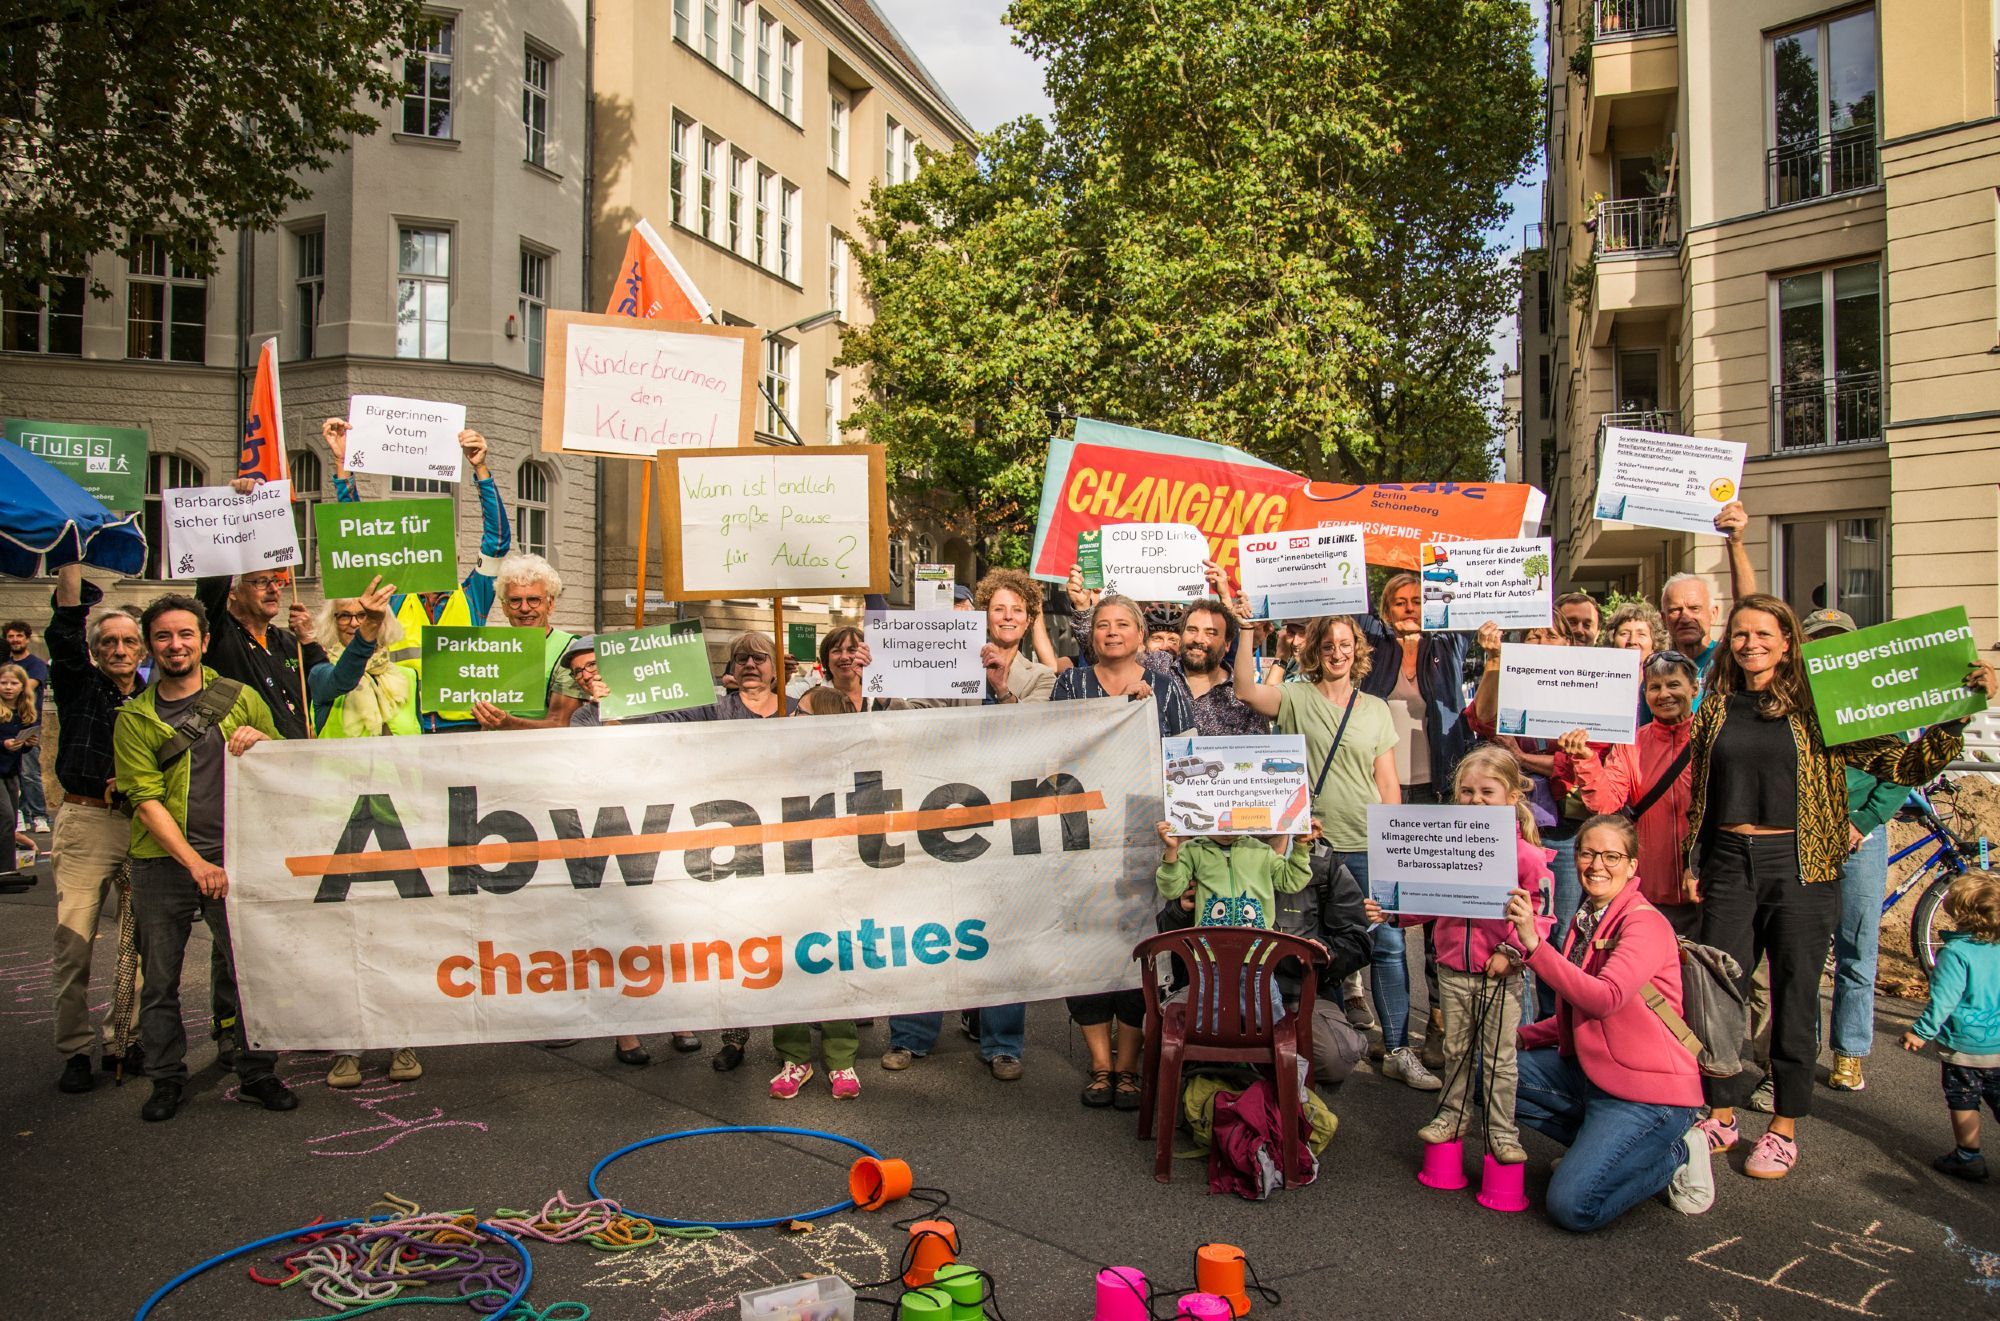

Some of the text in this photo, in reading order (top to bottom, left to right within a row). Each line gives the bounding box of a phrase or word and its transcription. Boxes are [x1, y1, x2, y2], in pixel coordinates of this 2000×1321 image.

[631, 386, 662, 406] den
[366, 405, 448, 423] Bürger:innen-
[386, 425, 427, 438] Votum
[596, 403, 718, 448] Kindern!
[29, 437, 104, 455] fuss
[382, 443, 428, 455] achten!
[1618, 443, 1646, 452] beteiligung
[1640, 438, 1666, 446] Menschen
[90, 462, 107, 470] e.V.
[744, 475, 767, 496] ist
[778, 474, 835, 494] endlich
[1645, 479, 1680, 488] Veranstaltung
[175, 489, 280, 508] Barbarossaplatz
[1373, 491, 1407, 501] Berlin
[1370, 500, 1440, 517] Schöneberg
[174, 508, 285, 528] sicher für unsere
[720, 505, 831, 536] große Pause
[340, 516, 430, 537] Platz für
[1317, 520, 1422, 539] VERSWENDE
[213, 529, 256, 544] Kinder!
[1112, 531, 1137, 541] CDU
[1141, 531, 1164, 540] SPD
[1246, 541, 1277, 552] CDU
[1290, 537, 1309, 549] SPD
[1318, 537, 1331, 545] DIE
[1450, 548, 1481, 557] Planung
[1483, 547, 1494, 555] für
[1511, 544, 1541, 553] Zukunft
[332, 547, 442, 569] Menschen
[1142, 547, 1167, 557] FDP:
[723, 548, 748, 573] für
[1277, 562, 1327, 573] unerwünscht
[1498, 557, 1524, 565] Kinder
[1105, 564, 1204, 574] Vertrauensbruch
[1502, 578, 1532, 587] Asphalt
[1457, 591, 1471, 599] und
[1494, 590, 1506, 598] für
[1508, 589, 1536, 597] Autos?
[873, 618, 977, 632] Barbarossaplatz
[437, 637, 522, 652] Parkbank
[600, 628, 696, 656] Die Zukunft
[883, 638, 967, 652] klimagerecht
[1807, 625, 1973, 675] Bürgerstimmen
[634, 659, 671, 681] geht
[893, 658, 957, 669] umbauen!
[459, 664, 499, 678] statt
[1506, 665, 1557, 675] Engagement
[1577, 669, 1632, 679] Bürger:innen
[1871, 665, 1919, 689] oder
[1537, 679, 1598, 689] ernst nehmen!
[440, 688, 524, 703] Parkplatz
[626, 683, 688, 705] zu Fuß.
[1187, 778, 1209, 786] Mehr
[1233, 777, 1248, 785] und
[1250, 776, 1301, 785] Entsiegelung
[1196, 788, 1293, 797] statt Durchgangsverkehr
[1232, 799, 1277, 808] Parkplätze!
[1390, 818, 1490, 829] Chance vertan für eine
[312, 770, 1095, 903] Abwarten
[1382, 832, 1499, 844] klimagerechte und lebens-
[1386, 847, 1495, 858] werte Umgestaltung des
[1397, 859, 1483, 871] Barbarossaplatzes?
